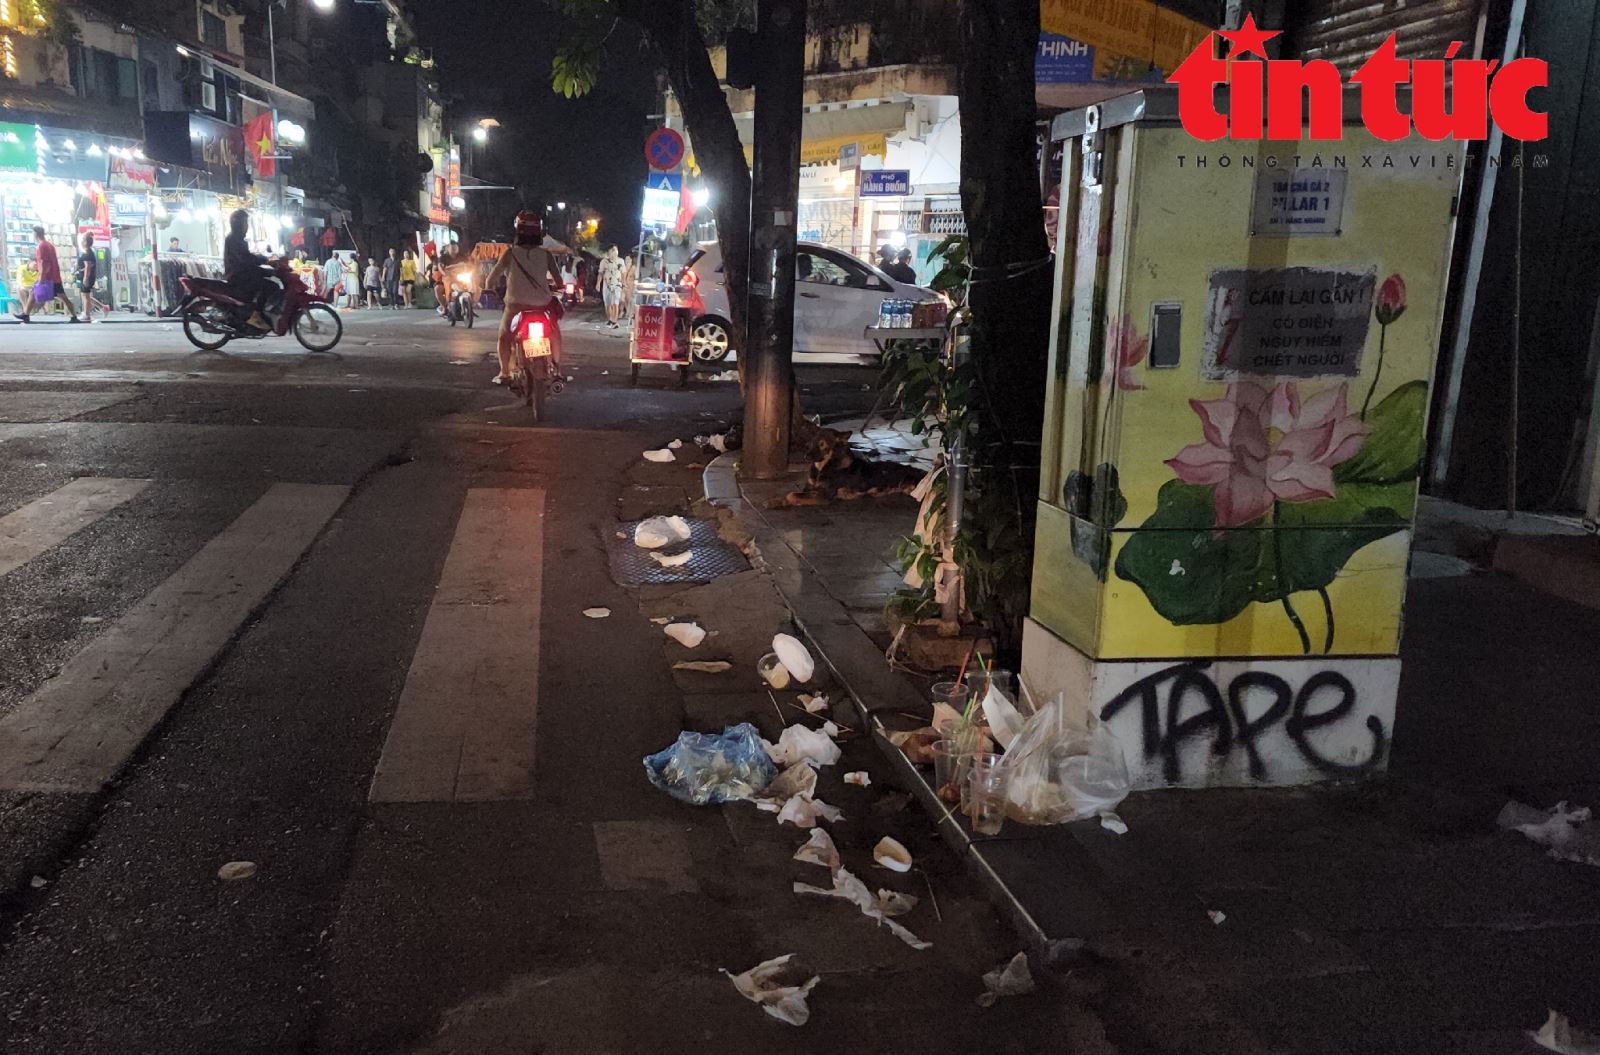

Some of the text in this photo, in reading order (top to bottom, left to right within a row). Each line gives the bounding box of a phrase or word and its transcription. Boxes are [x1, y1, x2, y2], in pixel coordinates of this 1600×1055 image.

[863, 178, 884, 192] HÀNG
[1322, 196, 1331, 212] 1
[1289, 288, 1316, 309] LẠI
[1273, 313, 1335, 331] CÓ ĐIỆN
[1258, 336, 1302, 349] NGUY
